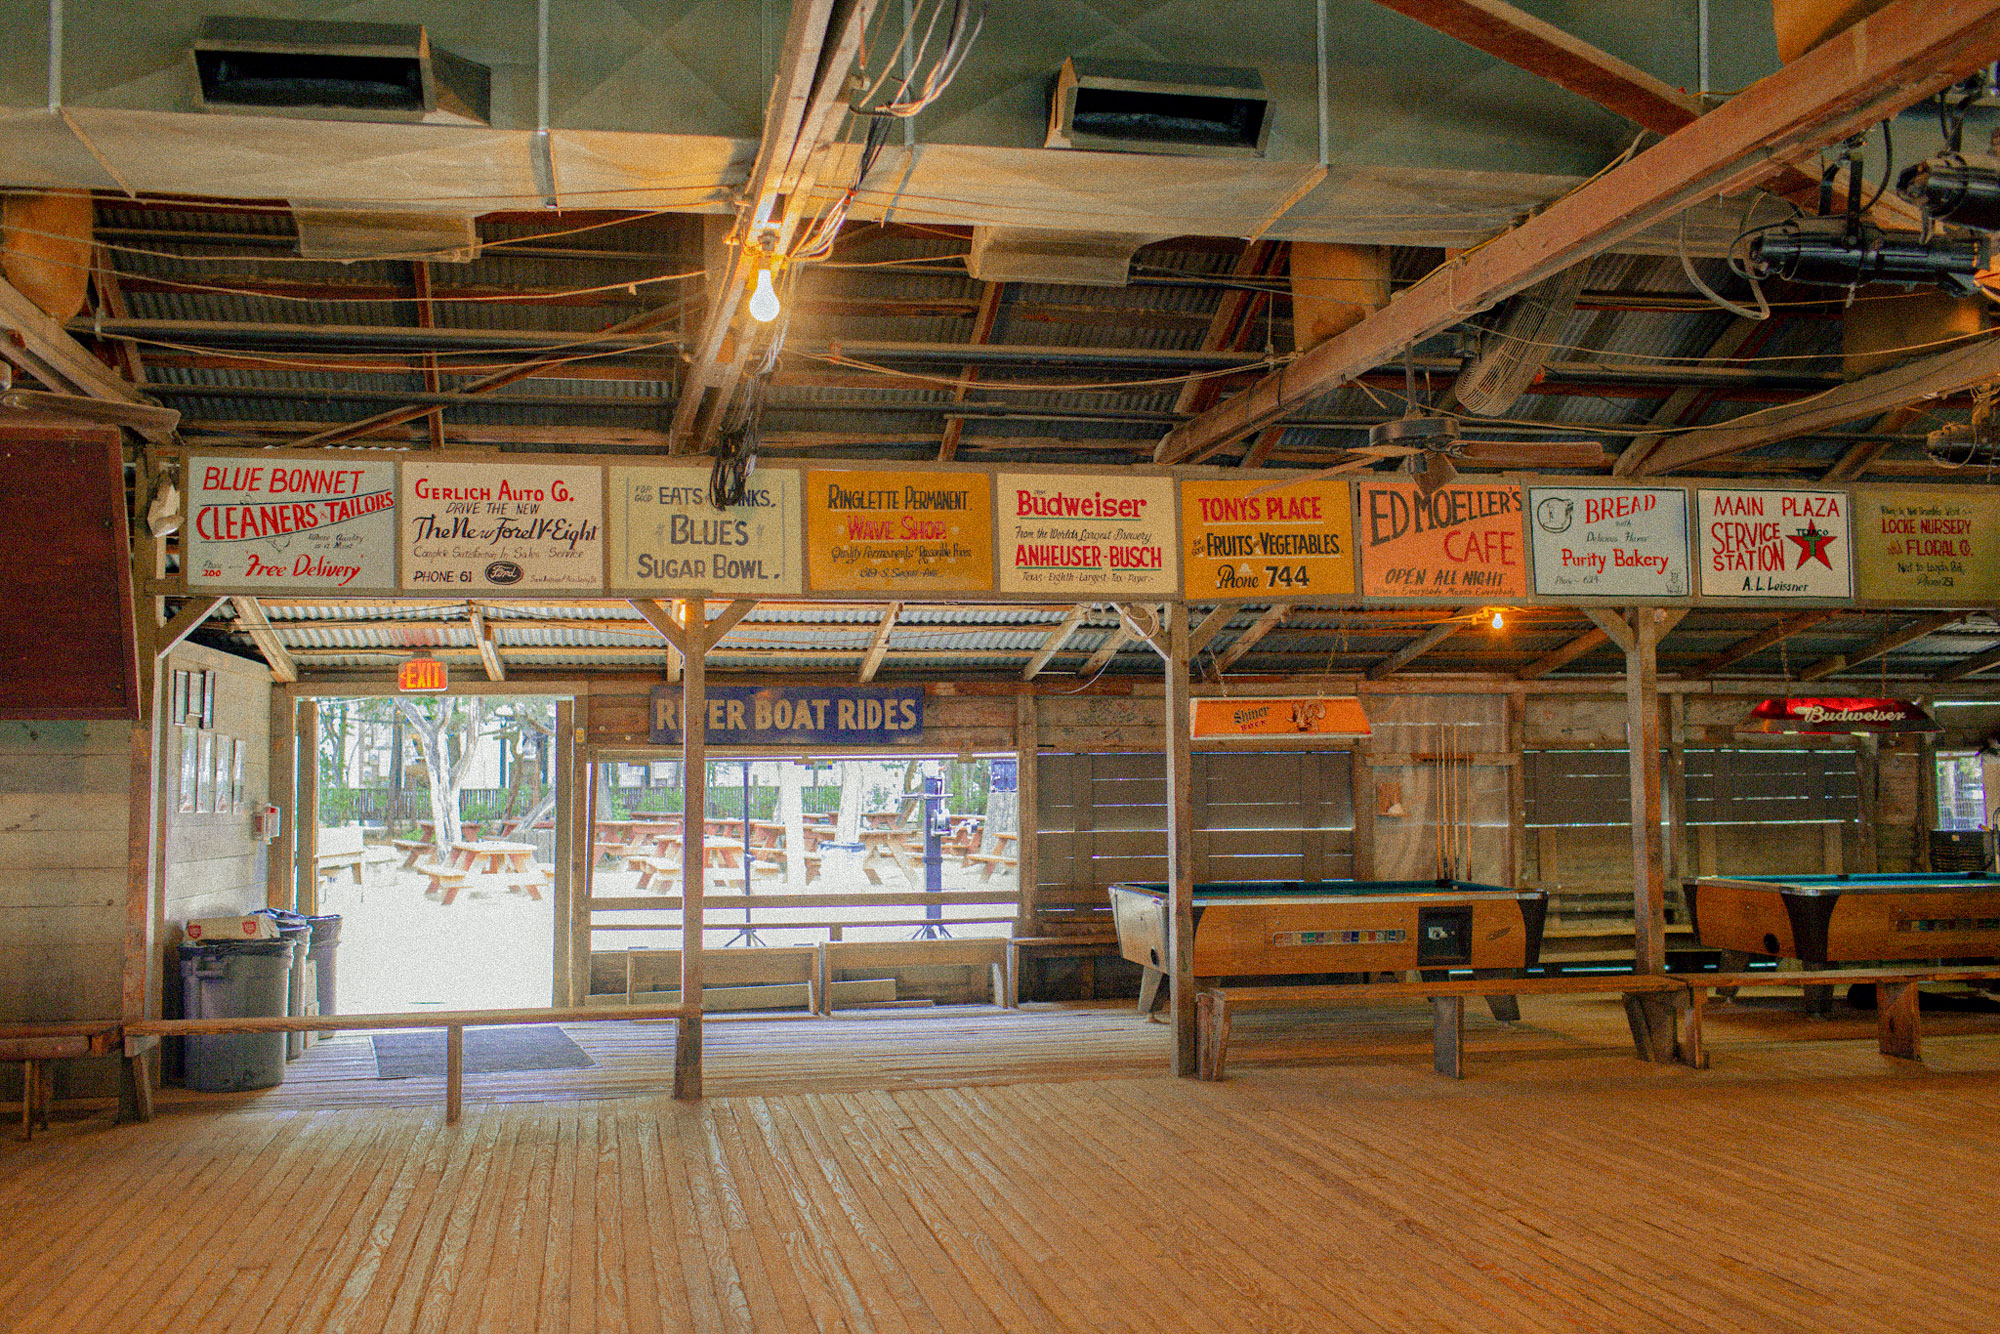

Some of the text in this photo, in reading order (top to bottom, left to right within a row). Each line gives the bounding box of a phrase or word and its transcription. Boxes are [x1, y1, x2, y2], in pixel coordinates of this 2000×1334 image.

[202, 466, 365, 494] BLUE BONNET
[415, 478, 491, 501] GERLICH
[498, 479, 545, 502] AUTO
[446, 502, 541, 515] DRIVE THE NEW
[659, 487, 703, 505] EATS
[828, 484, 899, 510] RINGLETTE
[1016, 490, 1147, 517] Budweiser
[1266, 496, 1322, 520] PLACE
[1714, 496, 1840, 517] MAIN PLAZA
[196, 503, 319, 541] CLEANERS
[324, 492, 394, 523] TAILORS
[1369, 486, 1522, 547] ED MOELLER'S
[1585, 494, 1656, 525] BREAD
[412, 514, 449, 545] The
[451, 517, 495, 540] New
[490, 516, 538, 546] Ford
[670, 514, 748, 545] BLUE'S
[847, 515, 894, 540] WAVE
[1015, 526, 1034, 540] From
[1037, 527, 1047, 540] the
[1078, 529, 1112, 542] Largest
[1114, 528, 1153, 545] Brewery
[1711, 522, 1780, 555] SERVICE
[1796, 528, 1829, 536] TEXACO
[1882, 518, 1971, 535] LOCKE NURSERY
[549, 547, 584, 559] Service
[1206, 533, 1254, 557] FRUITS
[1444, 530, 1516, 566] CAFE
[1712, 540, 1785, 572] STATION
[1905, 540, 1957, 557] FLORAL
[202, 569, 222, 577] 200
[293, 554, 361, 586] Delivery
[489, 564, 518, 580] Ford
[637, 553, 706, 578] SUGAR
[1561, 548, 1669, 575] Purity Bakery
[413, 571, 472, 582] PHONE 61
[1216, 564, 1310, 589] Phone 744
[1385, 567, 1507, 587] OPEN ALL NIGHT
[406, 662, 442, 688] EXIT
[656, 698, 917, 730] RIER BOAT RIDES
[1233, 706, 1271, 725] Shiner
[1794, 706, 1906, 723] Budweiser
